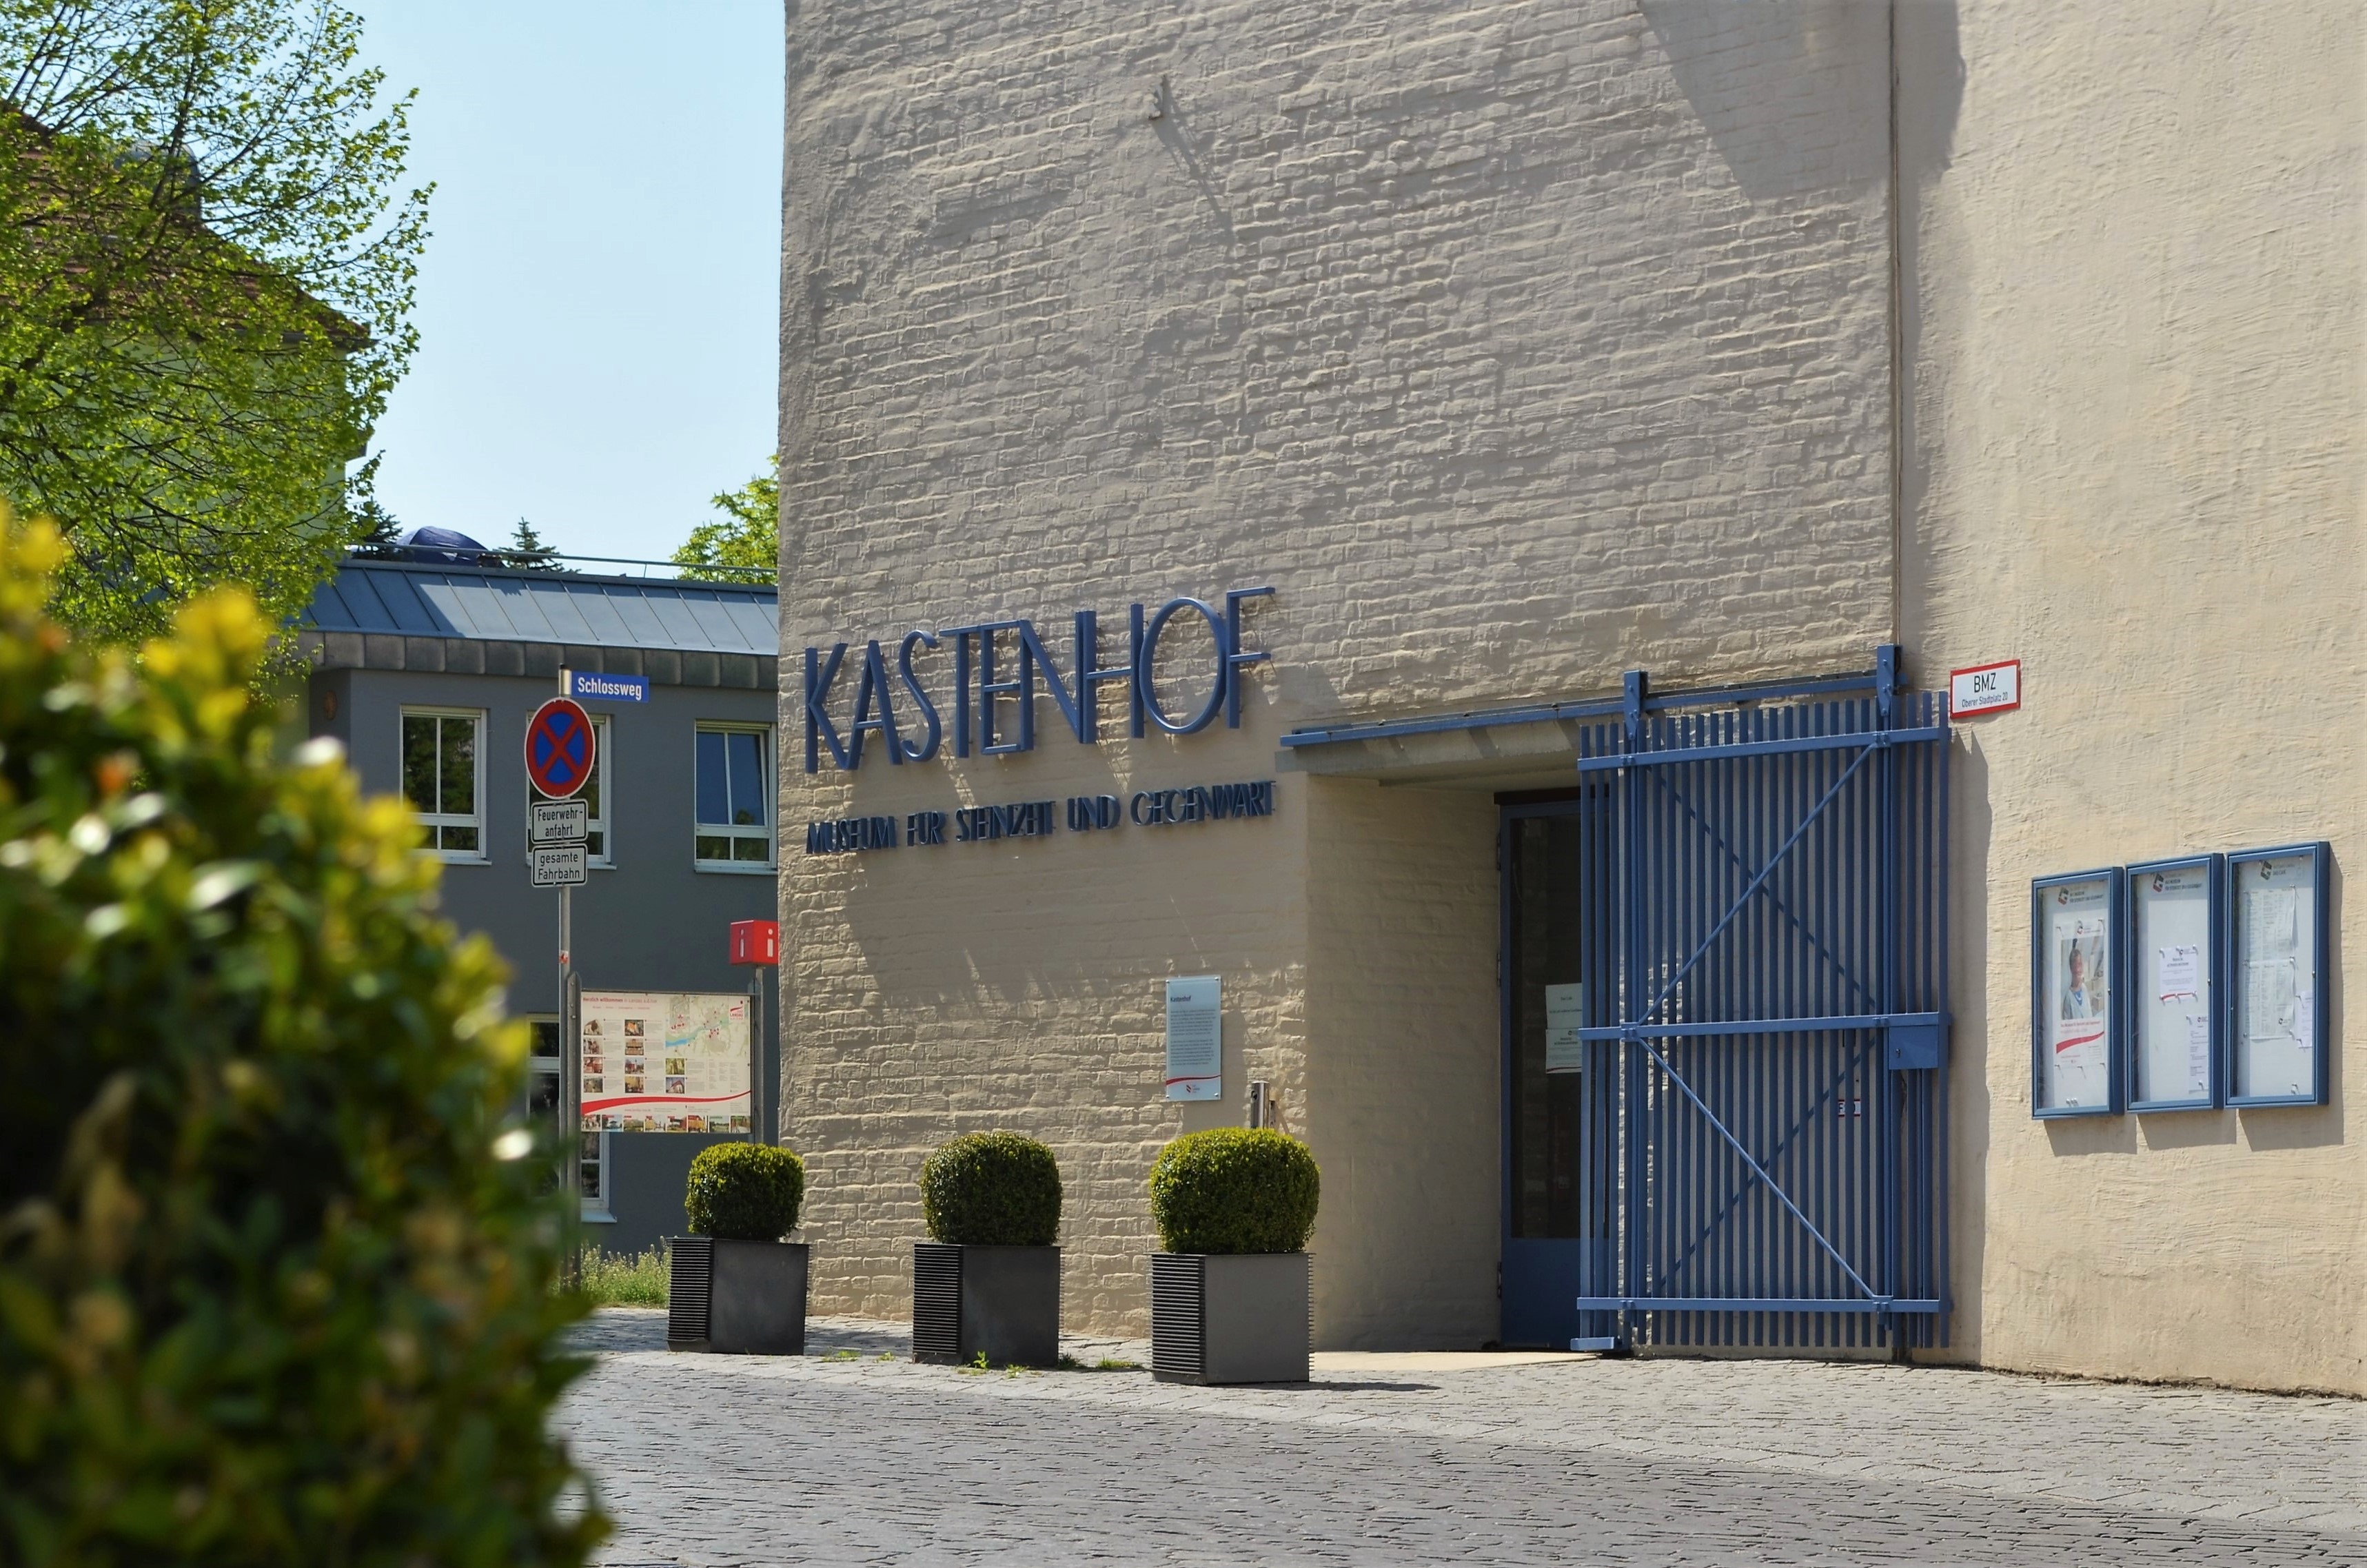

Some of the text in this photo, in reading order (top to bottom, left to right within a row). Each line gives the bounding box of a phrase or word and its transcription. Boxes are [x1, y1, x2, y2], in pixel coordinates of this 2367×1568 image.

[805, 587, 1275, 774] KASTENHOF
[1973, 673, 1996, 693] BMZ
[578, 677, 642, 701] Schlossweg
[1962, 699, 1978, 708] Oberer
[1979, 695, 2002, 706] Stadtplatz
[538, 808, 583, 822] Feuerwehr-
[806, 816, 898, 854] MUSEUM
[1067, 795, 1121, 832] UND
[1130, 780, 1276, 826] GEGENWART
[545, 824, 573, 837] anfahrt
[540, 853, 578, 866] gesamte
[538, 867, 580, 880] Fahrbahn
